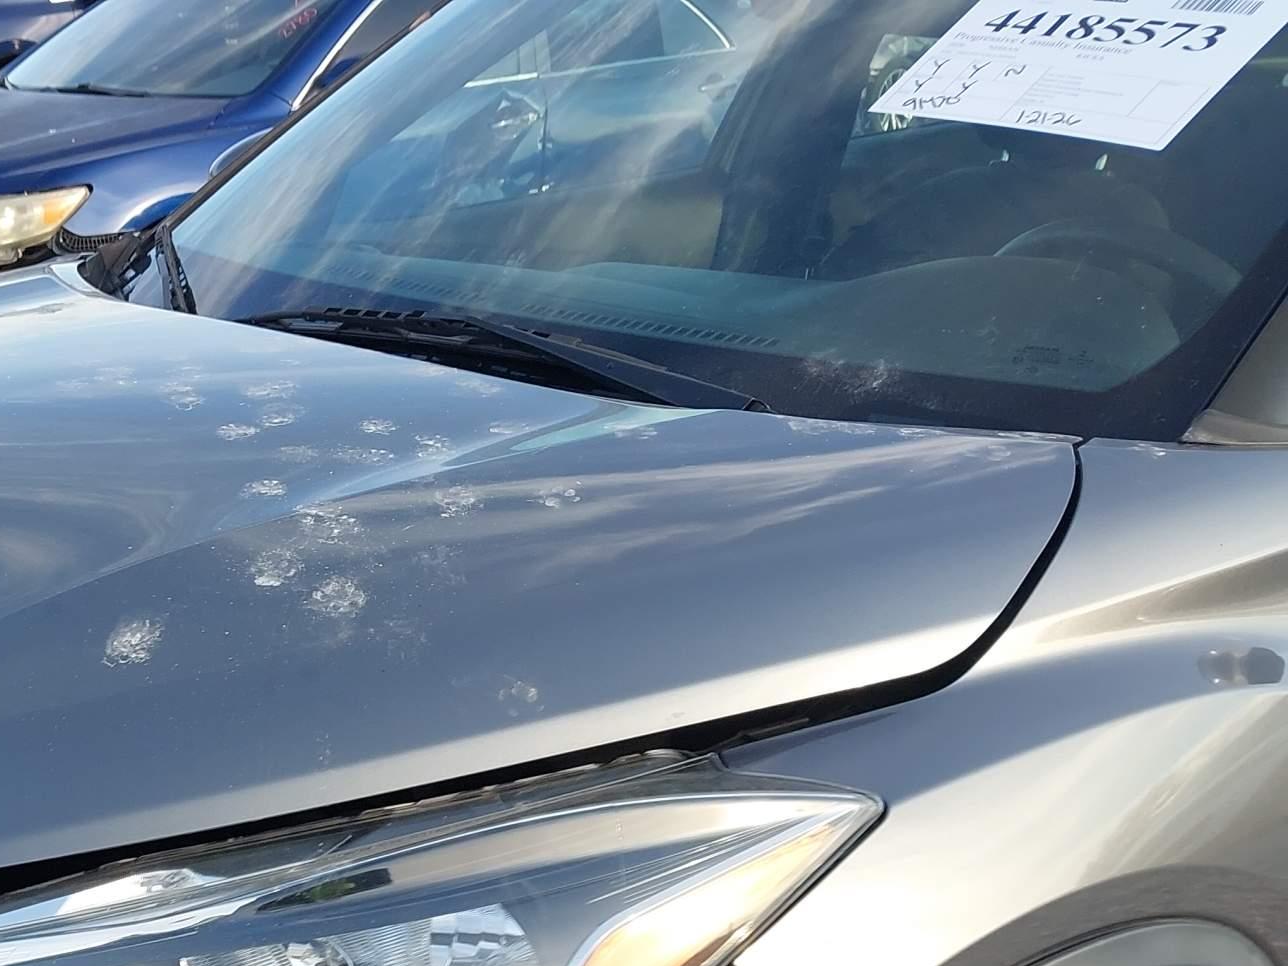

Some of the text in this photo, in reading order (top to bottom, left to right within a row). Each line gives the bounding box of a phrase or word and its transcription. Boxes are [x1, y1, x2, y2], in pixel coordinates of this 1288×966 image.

[953, 32, 1019, 46] Progressive
[1073, 42, 1133, 56] Insurance
[984, 8, 1227, 52] 44185573
